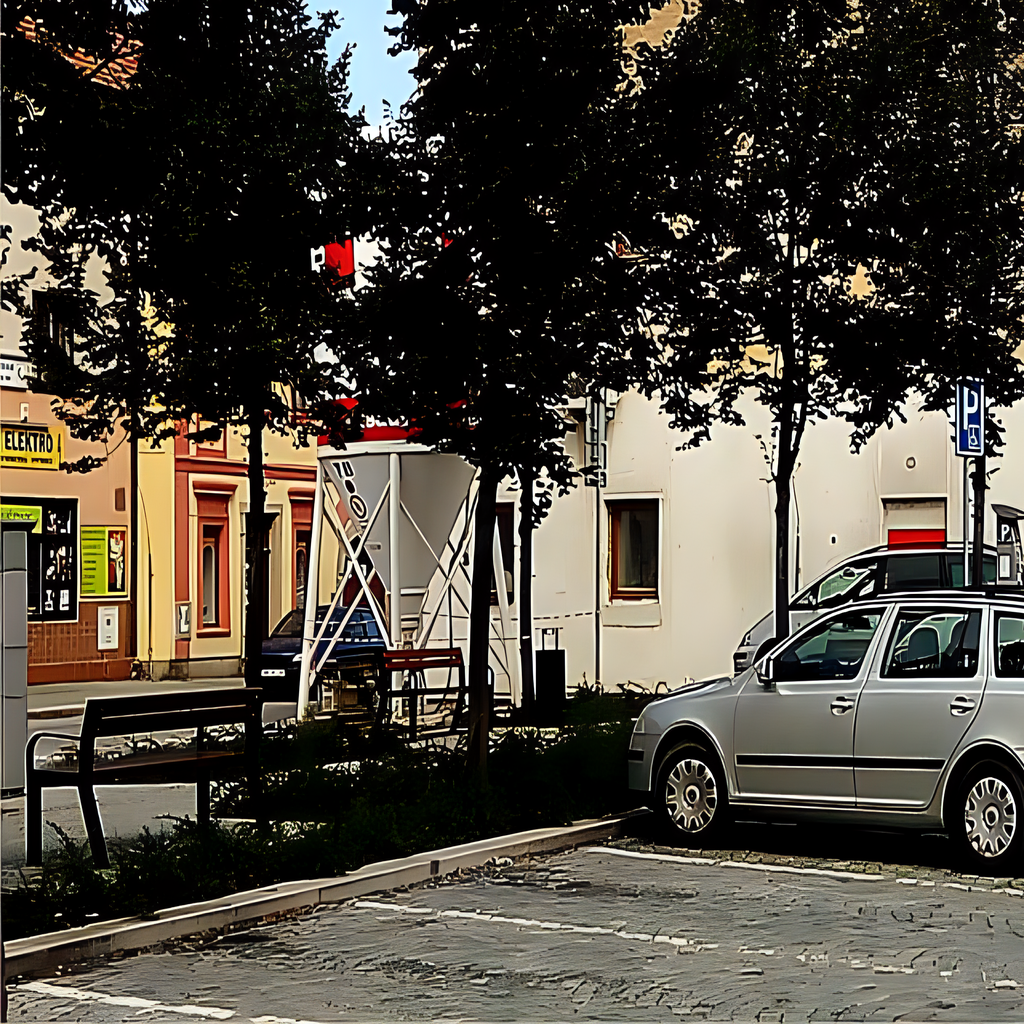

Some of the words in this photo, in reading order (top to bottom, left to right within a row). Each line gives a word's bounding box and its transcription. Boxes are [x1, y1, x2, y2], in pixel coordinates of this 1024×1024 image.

[963, 386, 979, 430] P
[4, 430, 54, 453] ELEKTRO
[1001, 524, 1010, 542] P
